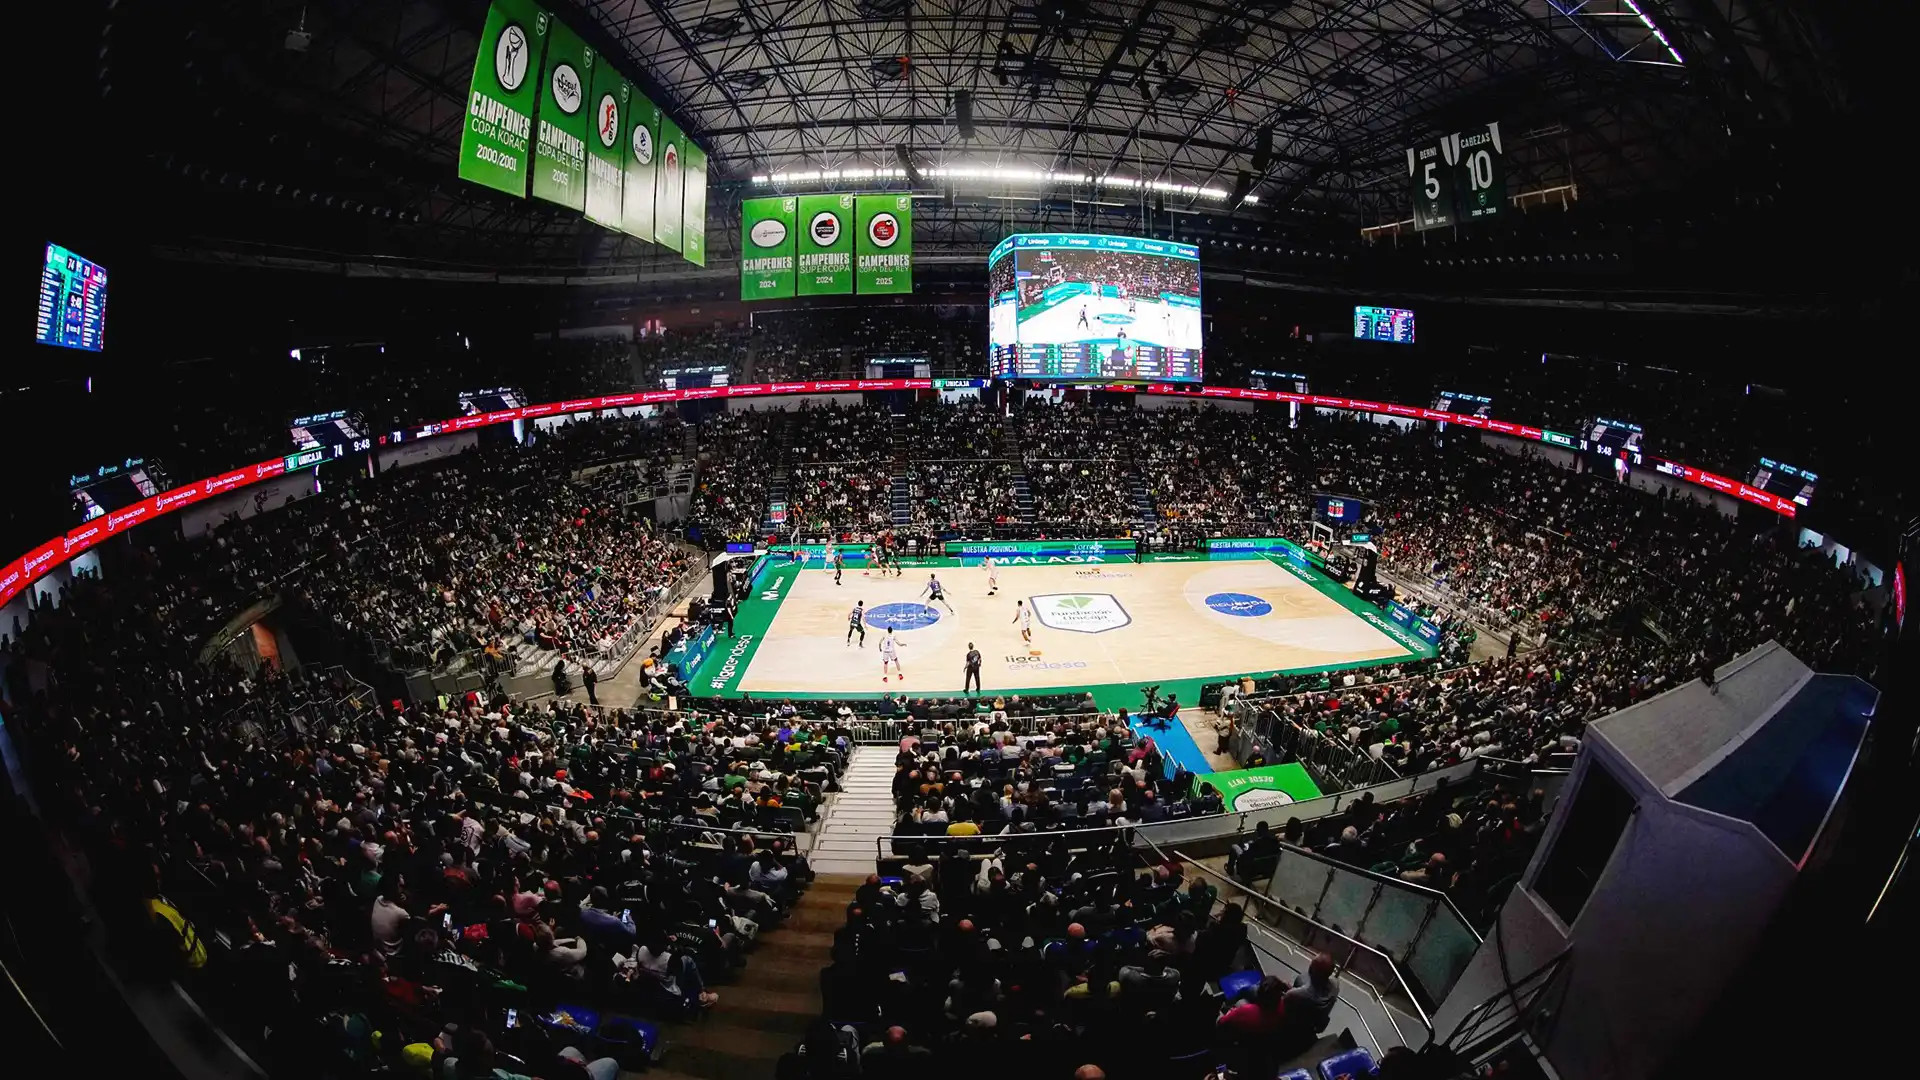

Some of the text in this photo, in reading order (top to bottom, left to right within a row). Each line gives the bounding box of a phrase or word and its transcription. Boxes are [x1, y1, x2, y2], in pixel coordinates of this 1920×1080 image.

[469, 92, 531, 140] CAMPEONES
[471, 123, 526, 152] COPA KORAC
[540, 120, 585, 161] CAMPEONES
[1460, 133, 1491, 149] CABEZAS
[475, 143, 518, 172] 2000/2001
[537, 141, 585, 173] COPA DEL REY
[1420, 147, 1437, 160] BERNI
[1466, 150, 1493, 191] 10
[1425, 162, 1440, 200] 5
[743, 256, 793, 271] CAMPEONES
[800, 252, 850, 267] CAMPEONES
[859, 254, 910, 267] CAMPEONES
[800, 265, 851, 274] SUPERCOPA
[859, 265, 878, 273] COPA
[759, 280, 777, 289] 2024
[816, 276, 834, 284] 2024
[876, 277, 893, 285] 2025
[946, 380, 970, 388] UNICAJA
[298, 451, 323, 466] UNICAJA
[333, 444, 343, 458] 74
[353, 438, 371, 452] 9:48
[1580, 439, 1588, 451] 74
[1597, 444, 1612, 456] 9:48
[963, 545, 988, 554] NUESTRA
[989, 544, 1017, 552] PROVINCIA
[991, 555, 1105, 565] MALAGA
[1051, 610, 1112, 618] Fundación
[711, 634, 753, 689] #ligaendesa
[1005, 655, 1041, 663] liga
[1009, 661, 1087, 671] endesa
[1248, 776, 1274, 784] DESDE
